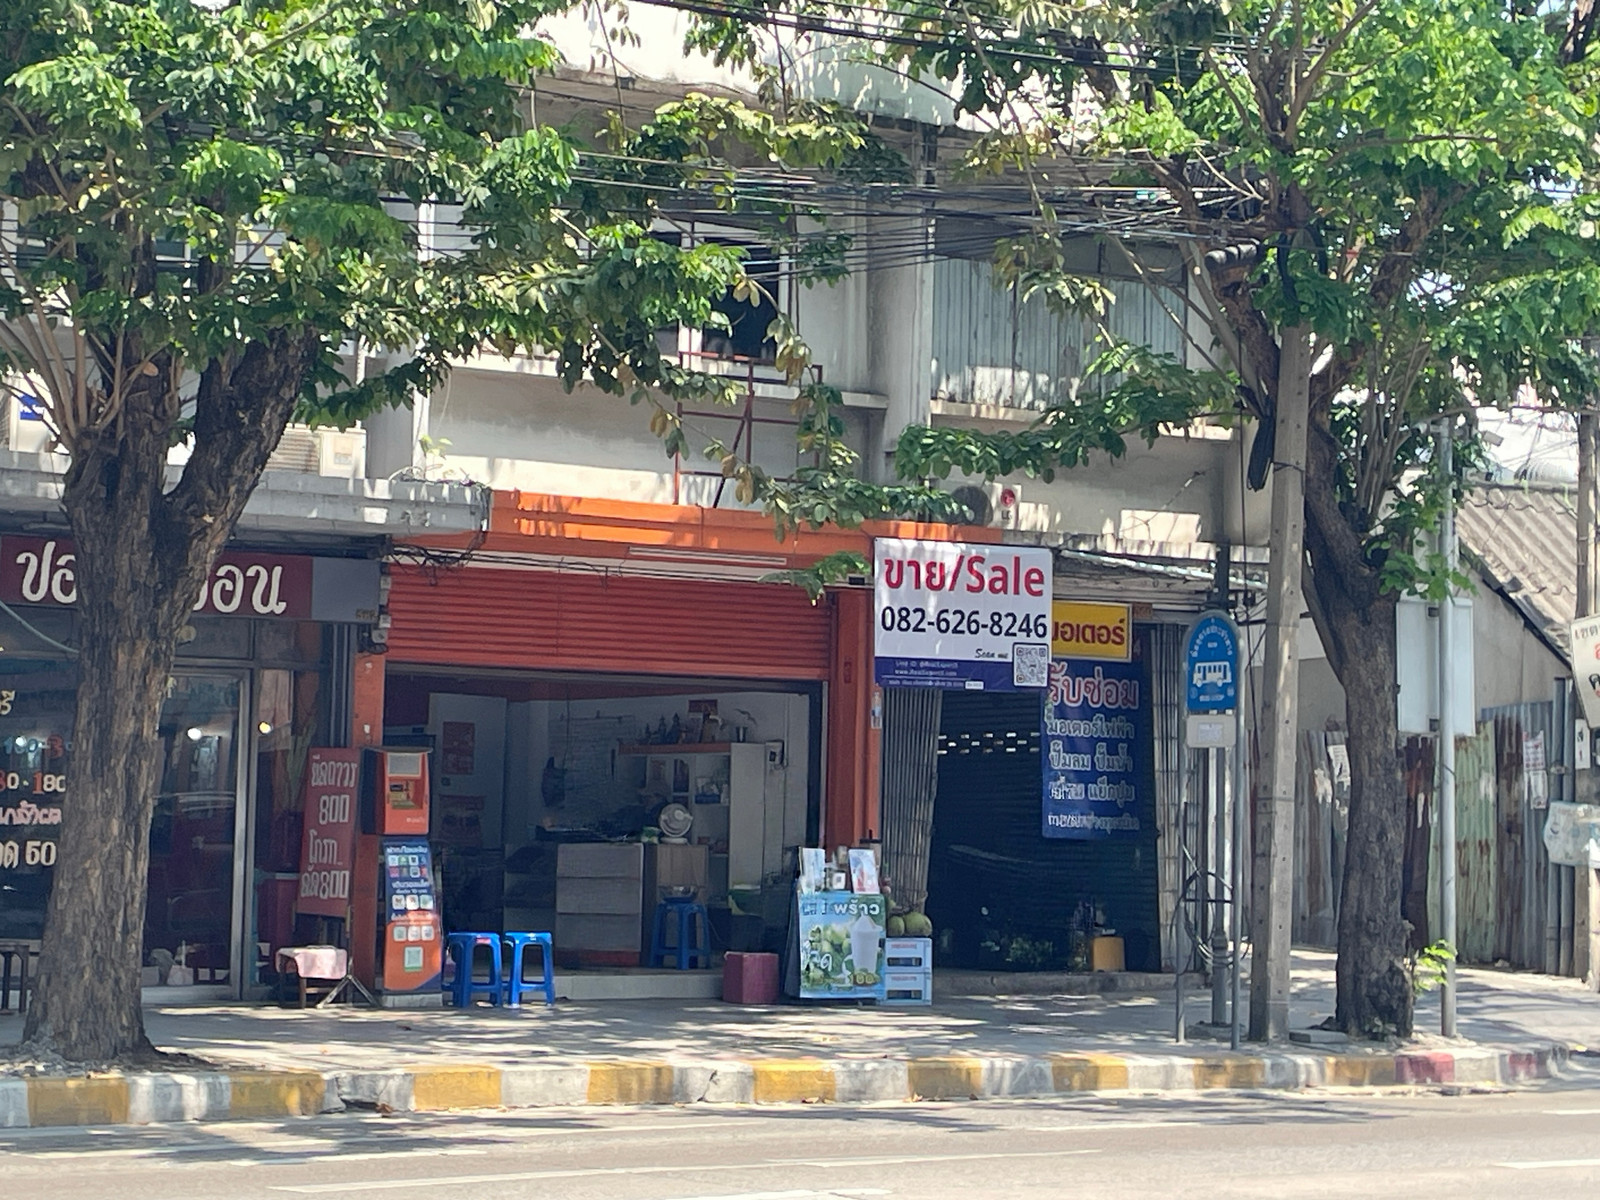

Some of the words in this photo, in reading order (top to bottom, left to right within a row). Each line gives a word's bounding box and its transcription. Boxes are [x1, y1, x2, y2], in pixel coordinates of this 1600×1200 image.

[884, 554, 1045, 597] ขาย/Sale
[881, 606, 1048, 639] 082-626-8246
[319, 794, 350, 825] 800
